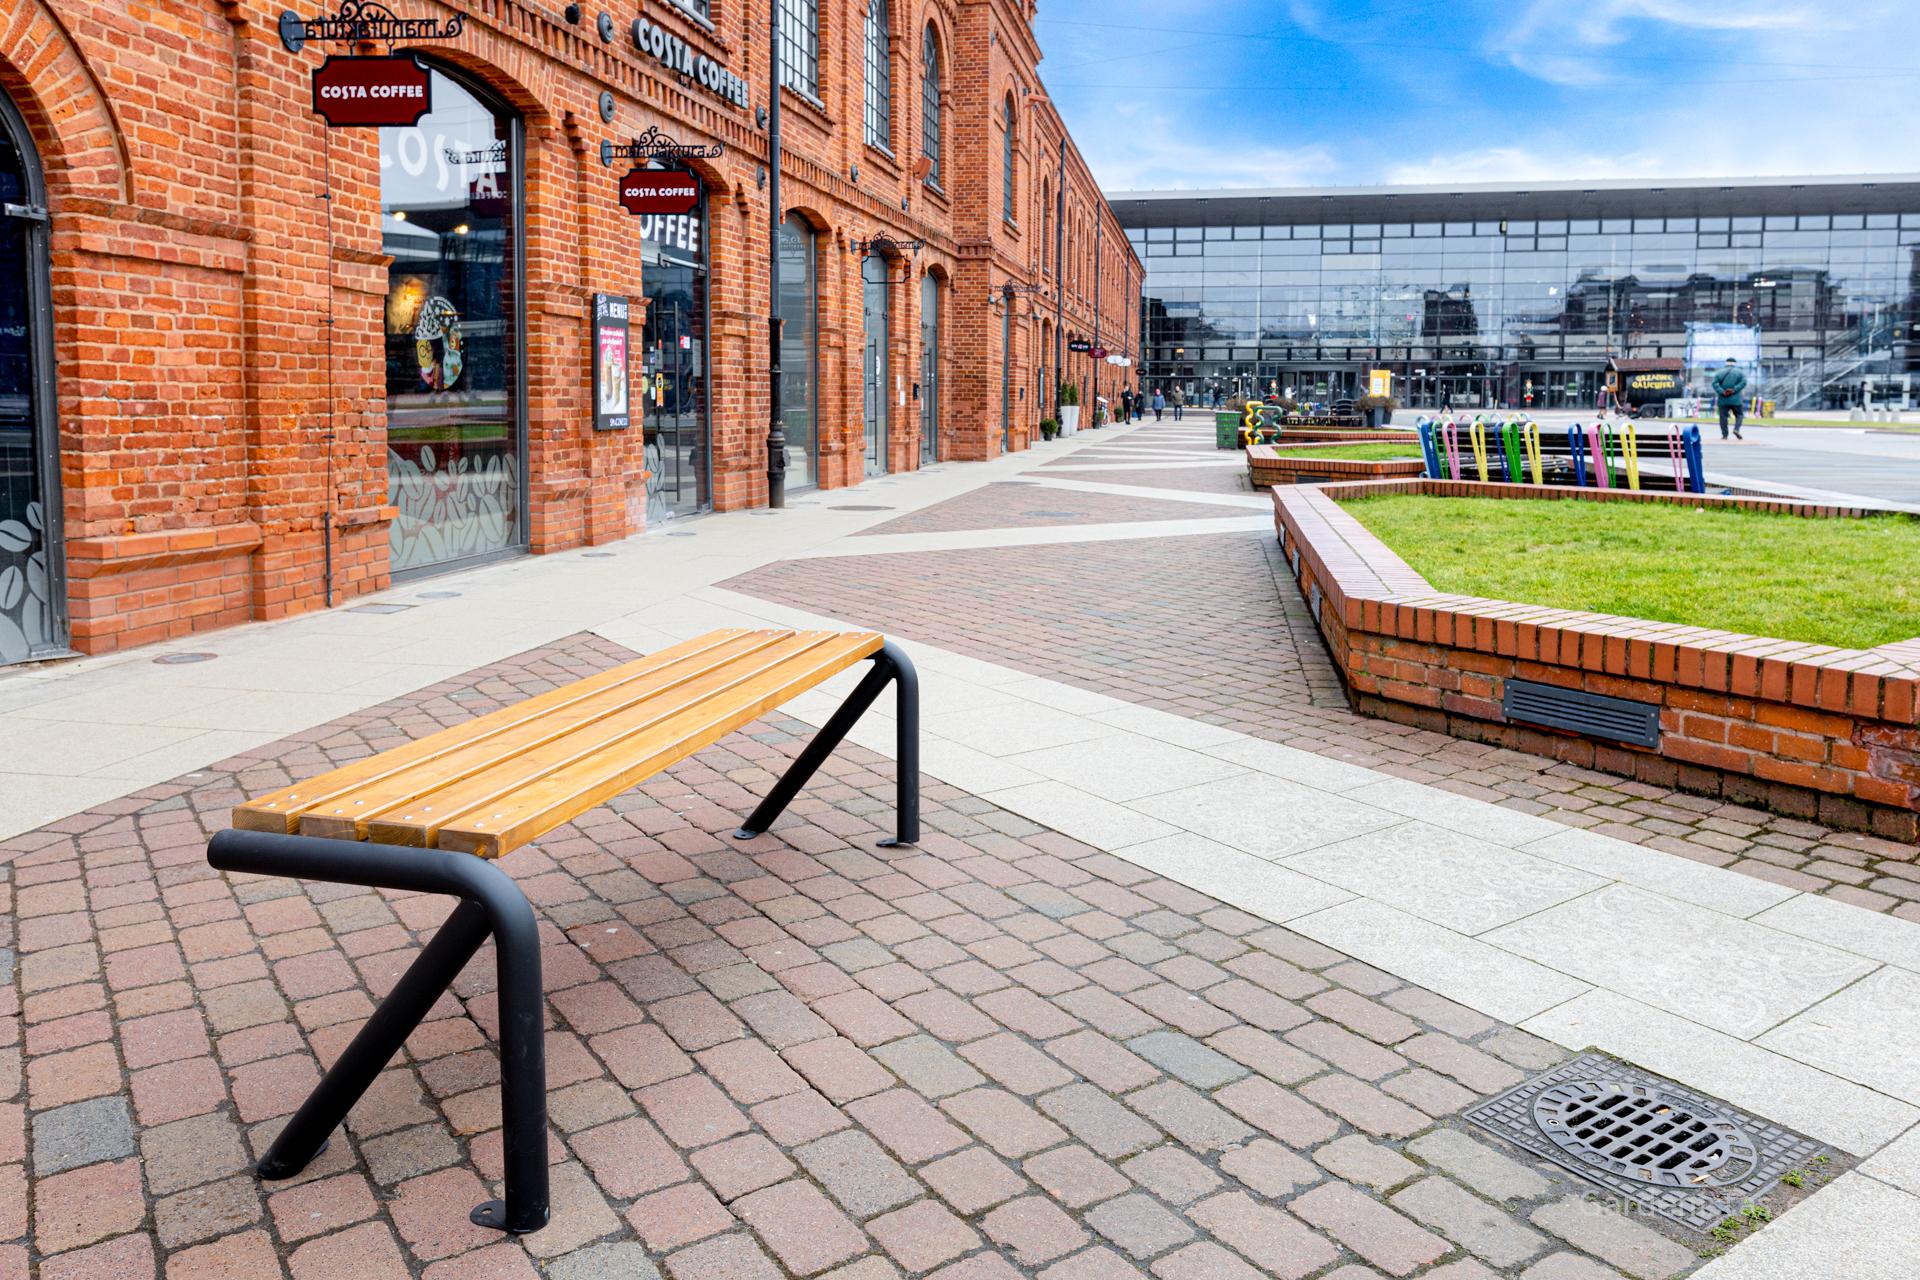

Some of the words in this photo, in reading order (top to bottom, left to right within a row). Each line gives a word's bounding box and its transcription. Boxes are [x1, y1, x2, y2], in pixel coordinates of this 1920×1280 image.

[633, 18, 694, 77] COSTA
[695, 55, 748, 109] COFFEE
[321, 86, 367, 99] COSTA
[370, 85, 423, 98] COFFEE
[379, 127, 500, 197] OSTA
[625, 188, 656, 197] COSTA
[659, 187, 695, 196] COFFEE
